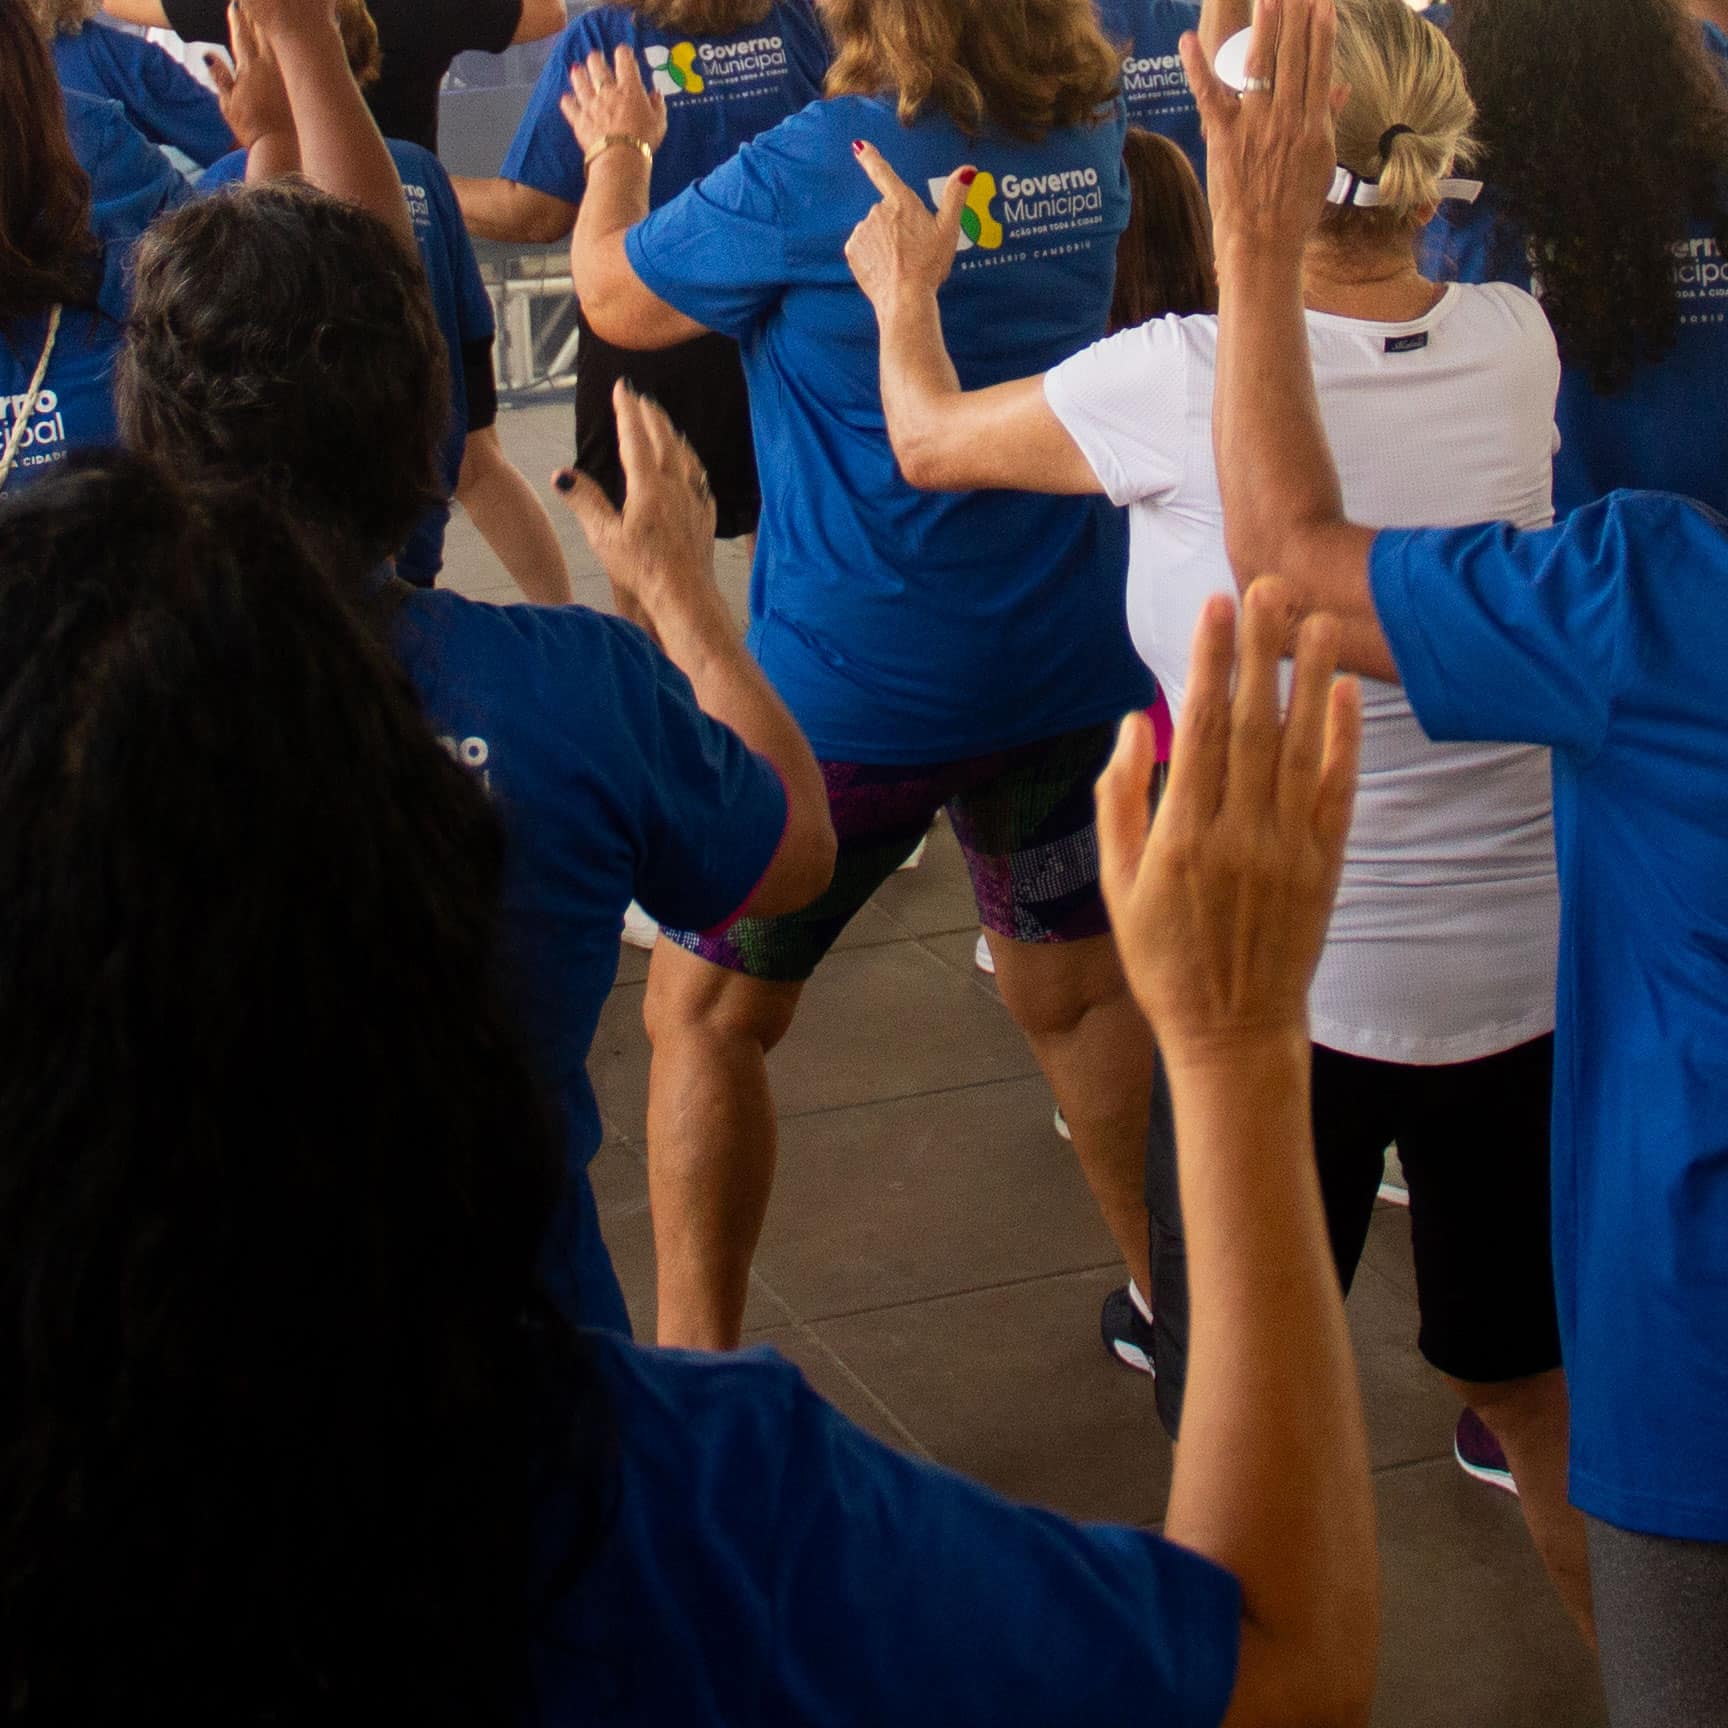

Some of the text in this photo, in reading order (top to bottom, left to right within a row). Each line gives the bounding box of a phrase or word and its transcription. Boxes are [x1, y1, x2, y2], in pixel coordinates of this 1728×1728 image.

[699, 36, 783, 61] Governo
[702, 49, 787, 76] Municipal
[1122, 54, 1183, 74] Gover
[1001, 167, 1098, 199] Governo
[1003, 186, 1102, 223] Municipal
